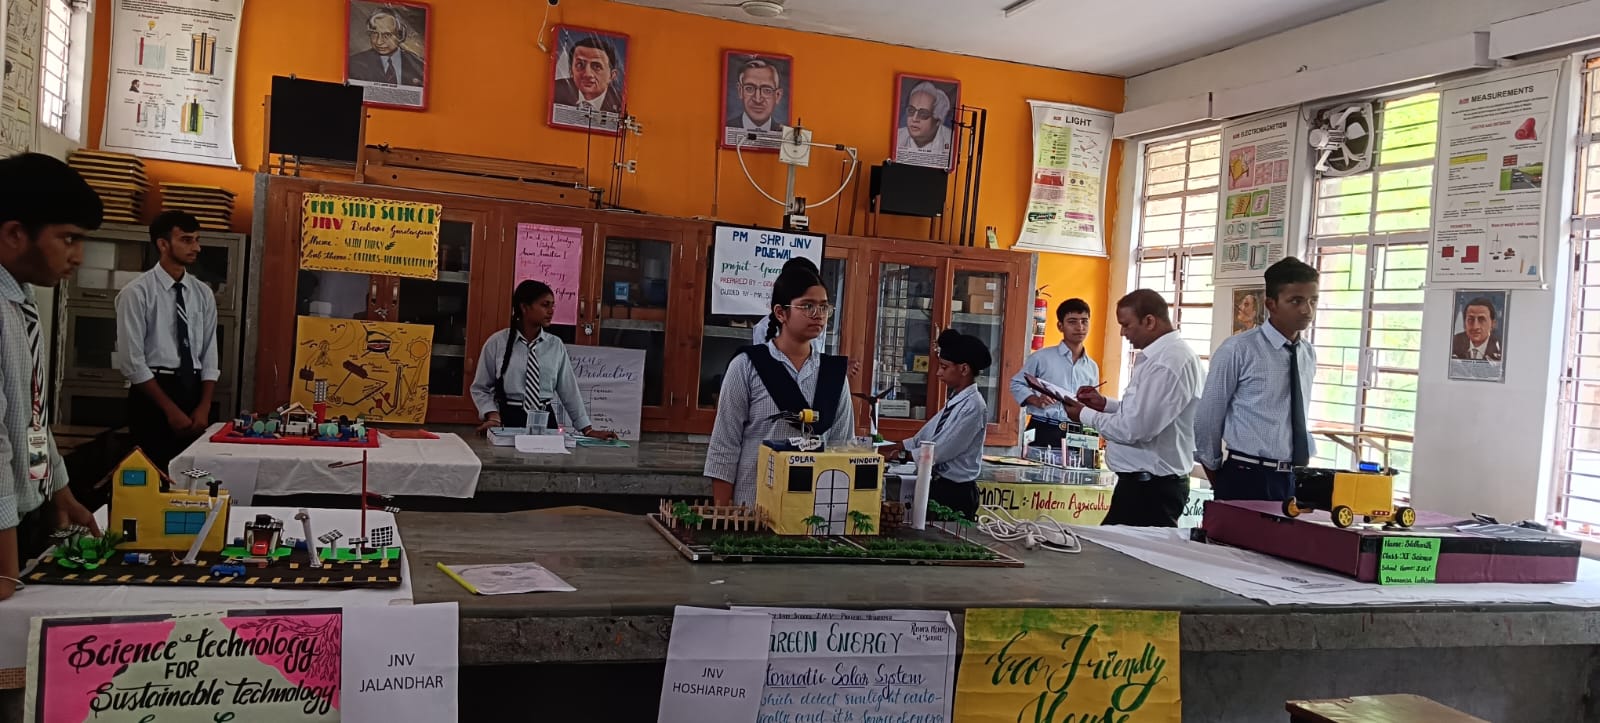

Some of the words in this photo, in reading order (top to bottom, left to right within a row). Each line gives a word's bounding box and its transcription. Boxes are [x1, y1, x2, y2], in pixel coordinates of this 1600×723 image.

[1471, 85, 1534, 102] MEASUREMENTS
[1065, 115, 1092, 126] LIGHT
[1241, 121, 1287, 137] ELECTROMAGNETISM
[311, 200, 334, 215] PM
[381, 205, 435, 224] SCHOOL
[312, 216, 343, 230] JNV
[733, 231, 749, 242] PM
[760, 234, 785, 246] SHRI
[790, 238, 812, 250] JNV
[755, 246, 792, 260] POJEWAL
[789, 455, 815, 464] SOLAR
[849, 456, 881, 464] WINDOW
[977, 486, 1019, 511] MODEL
[1031, 490, 1065, 511] Modern
[1068, 493, 1110, 519] Agricultu
[827, 622, 904, 654] ENERGY
[64, 635, 178, 673] Science
[180, 625, 320, 673] technology
[388, 653, 416, 668] JNV
[1046, 624, 1168, 712] Friendly
[165, 660, 199, 679] FOR
[702, 667, 724, 679] JNV
[360, 675, 444, 693] JALANDHAR
[766, 663, 827, 687] tomatic
[831, 662, 869, 687] Solar
[874, 663, 926, 699] System
[87, 682, 225, 718] Sustainable
[226, 677, 337, 715] technology
[672, 682, 747, 699] HOSHIARPUR
